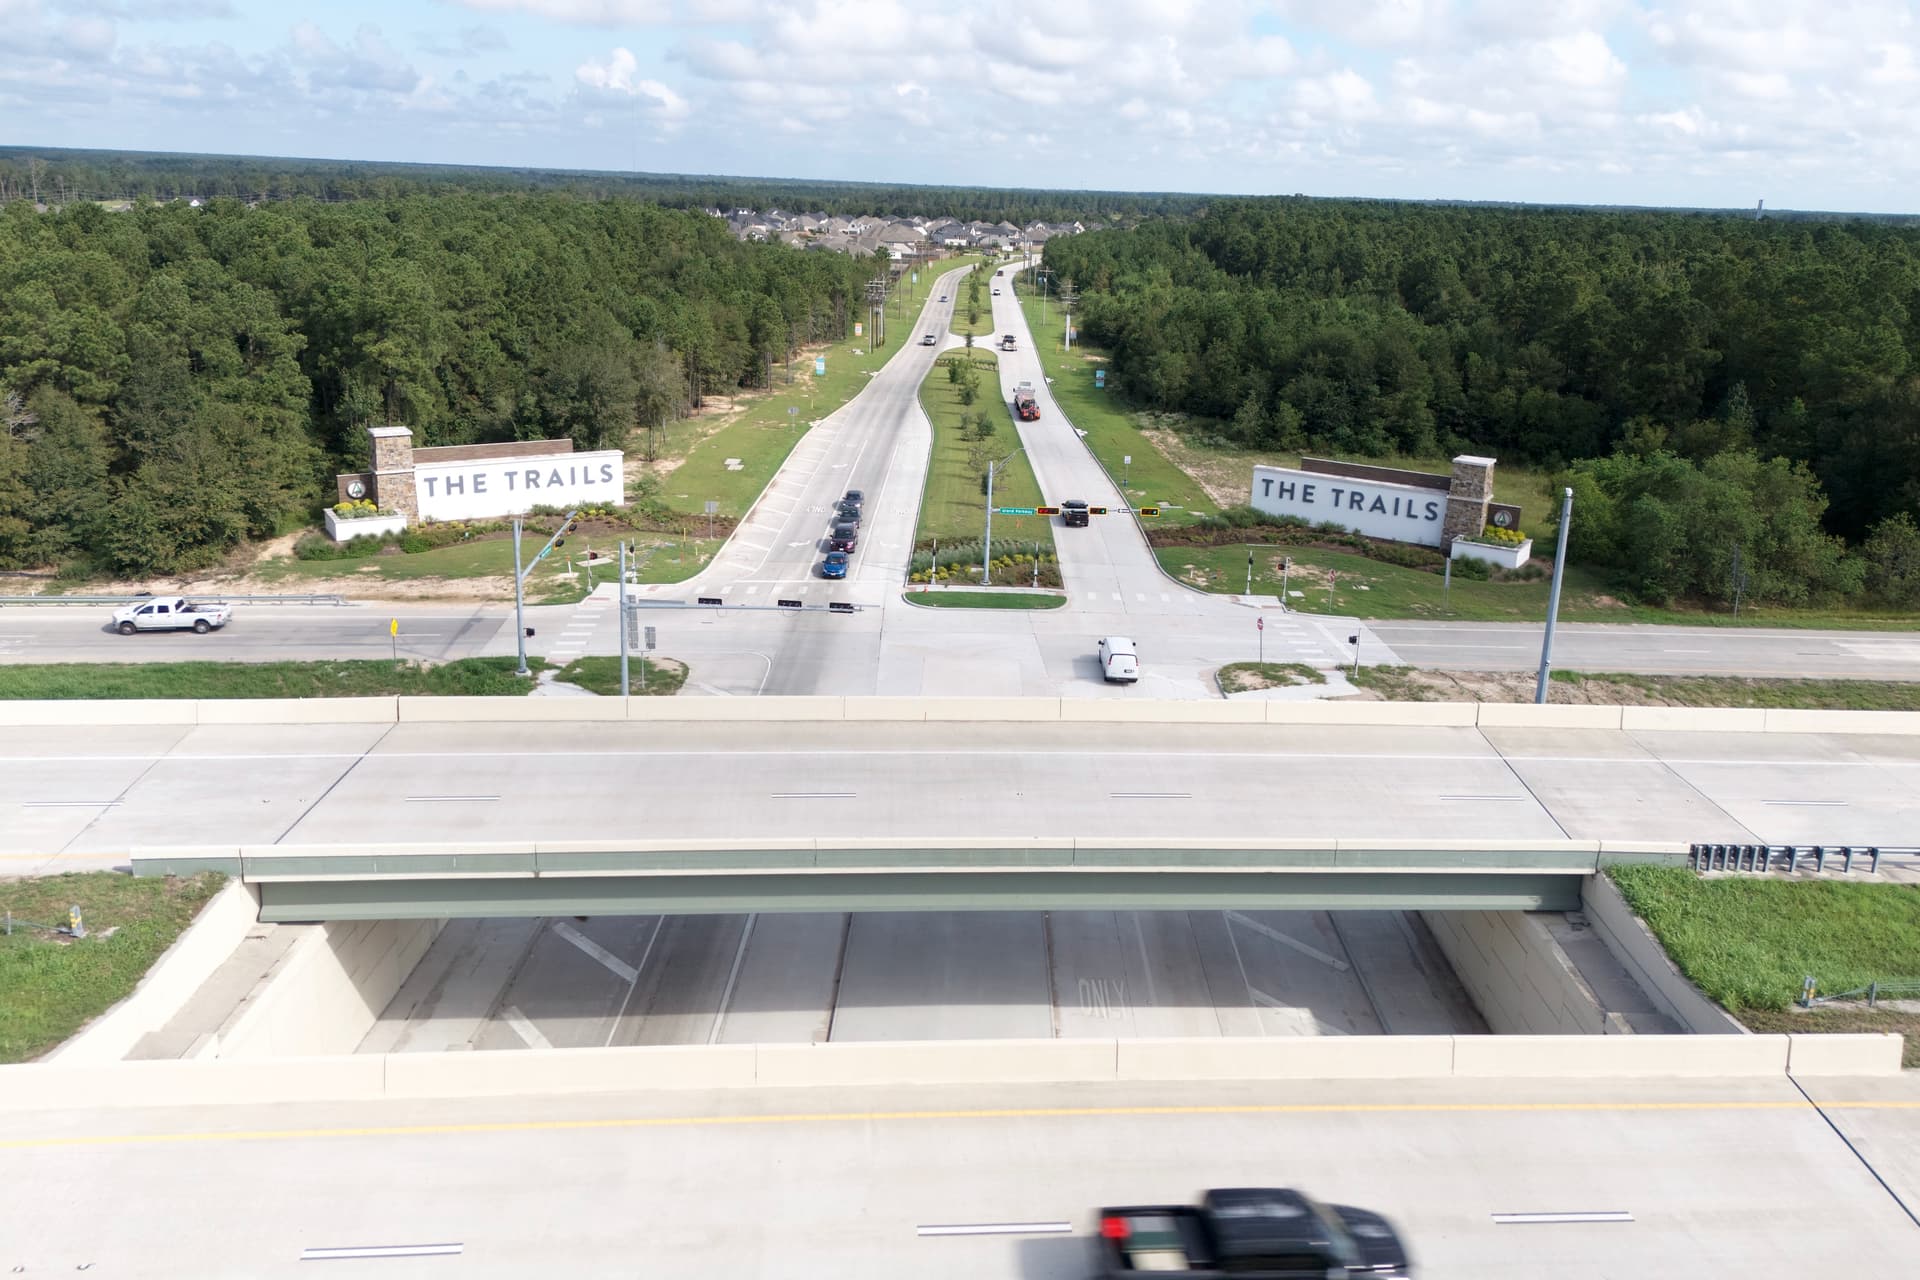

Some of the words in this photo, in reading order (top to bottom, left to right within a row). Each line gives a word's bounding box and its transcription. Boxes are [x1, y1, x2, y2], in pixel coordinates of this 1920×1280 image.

[424, 473, 487, 497] THE
[504, 464, 613, 491] TRAILS
[1262, 478, 1316, 503] THE
[1332, 488, 1438, 521] TRAILS
[1079, 978, 1127, 1019] ONLY
